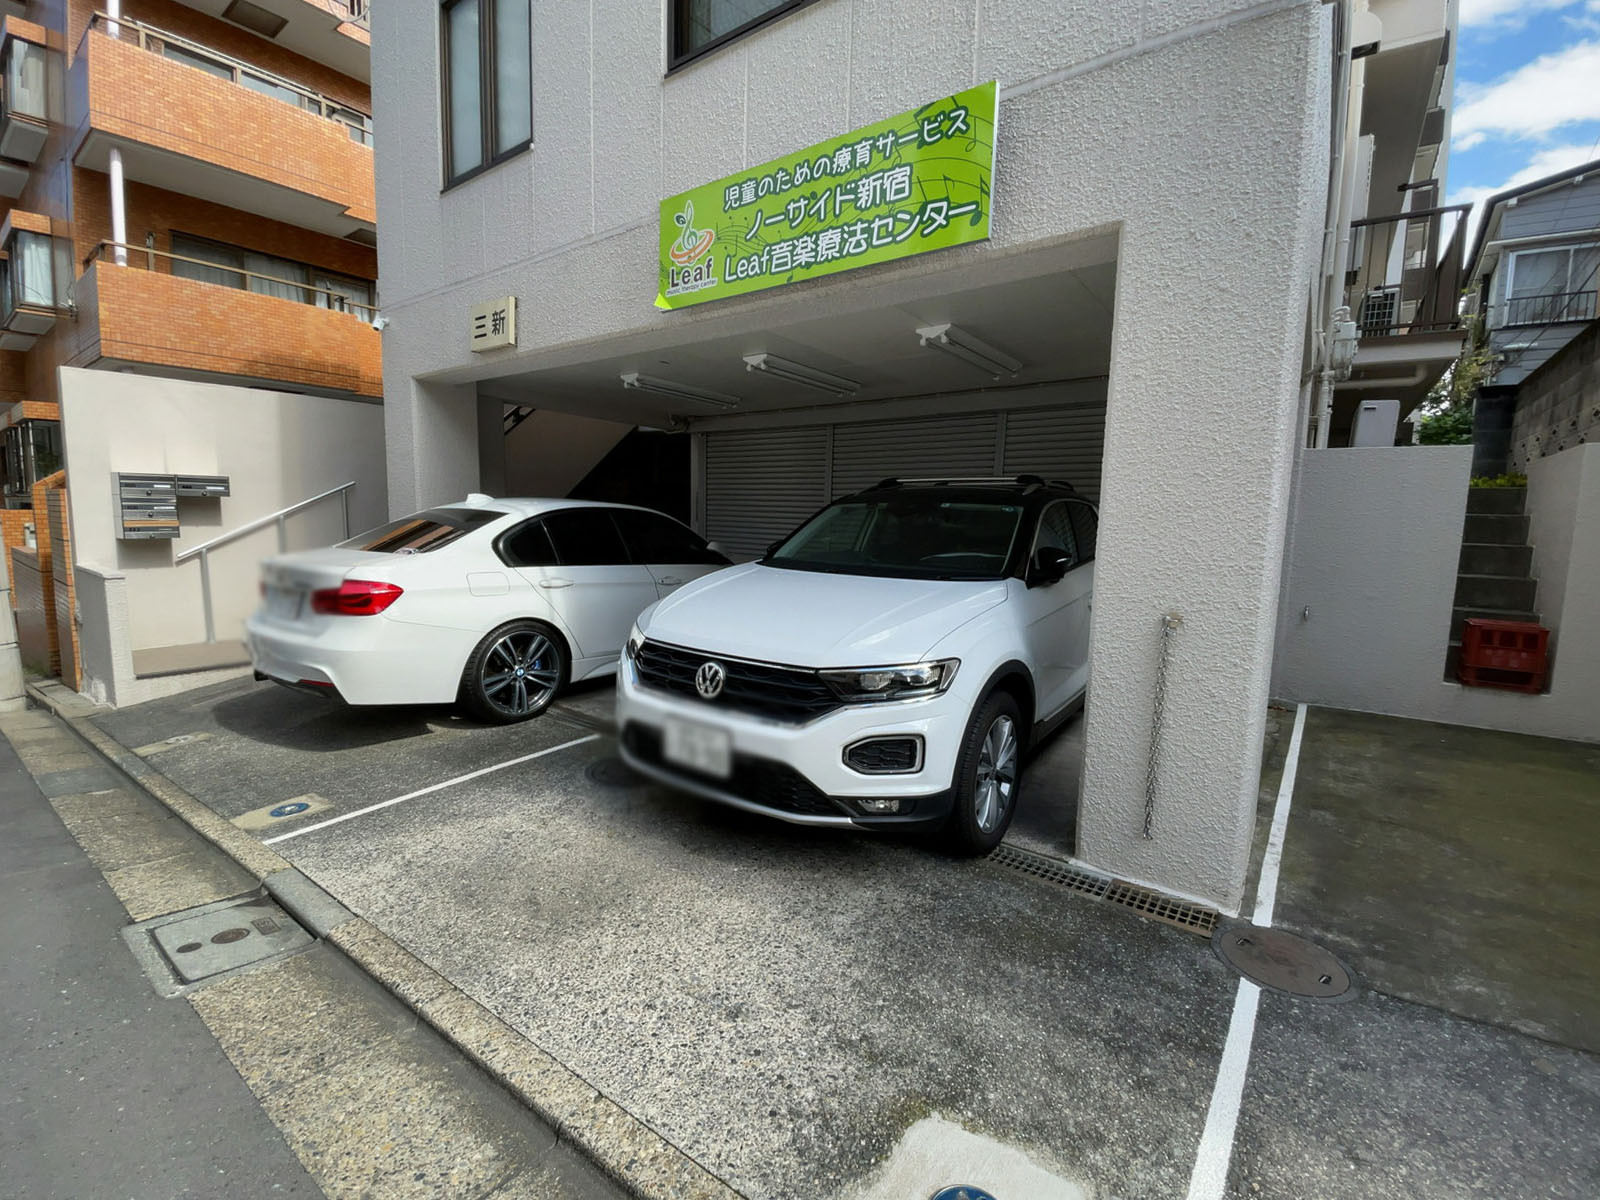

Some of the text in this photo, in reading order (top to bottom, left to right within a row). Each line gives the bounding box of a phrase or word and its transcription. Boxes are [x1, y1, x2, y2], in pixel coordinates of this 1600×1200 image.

[723, 109, 969, 210] 児童のための療育サービス
[724, 201, 978, 282] Leaf音楽療法センター
[745, 166, 911, 240] ノーサイド新宿
[671, 257, 712, 288] Leaf
